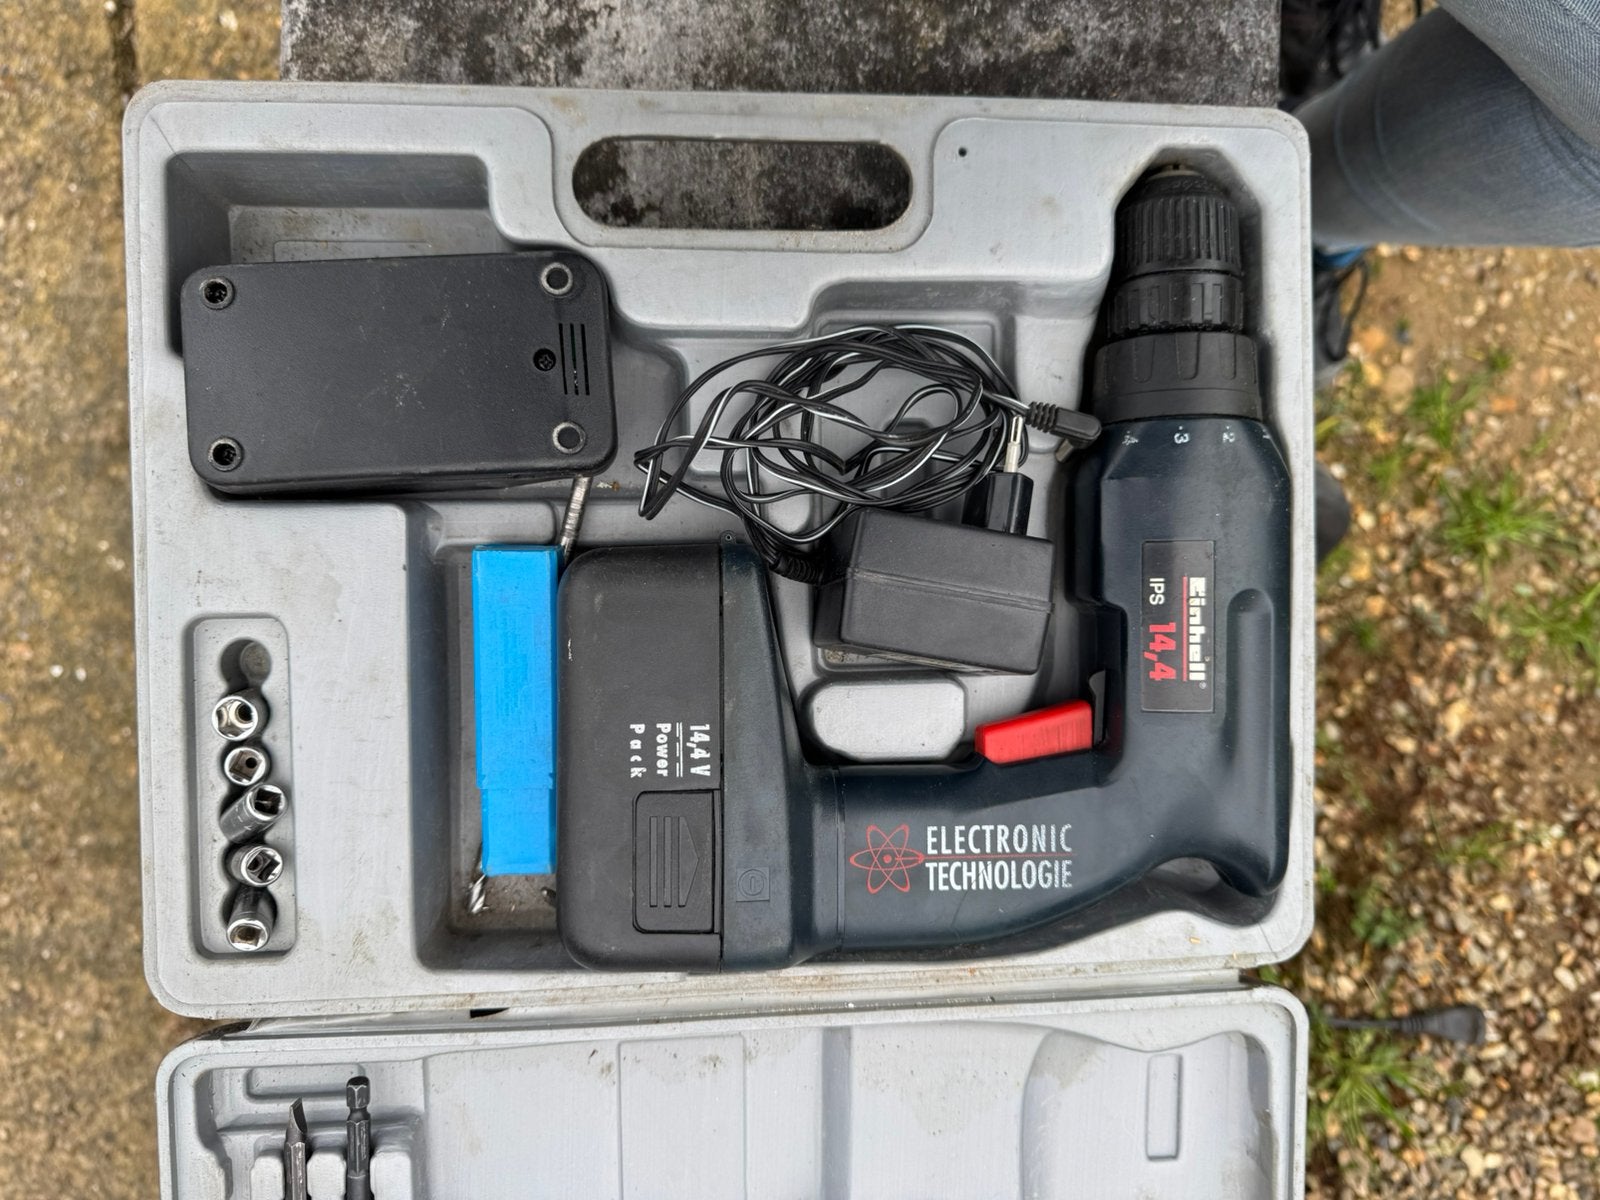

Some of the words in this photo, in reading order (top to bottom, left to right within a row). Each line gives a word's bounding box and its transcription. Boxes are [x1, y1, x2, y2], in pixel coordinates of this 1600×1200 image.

[1173, 432, 1190, 444] 3
[1222, 432, 1236, 444] 2
[1149, 577, 1166, 606] IPS
[1188, 577, 1206, 681] Einhell
[1143, 622, 1177, 681] 14,4
[629, 723, 647, 778] Pack
[655, 722, 672, 777] Power
[686, 723, 711, 760] 14,4
[690, 764, 711, 777] V
[926, 823, 1073, 855] ELECTRONIC
[925, 859, 1073, 892] TECHNOLOGIE
